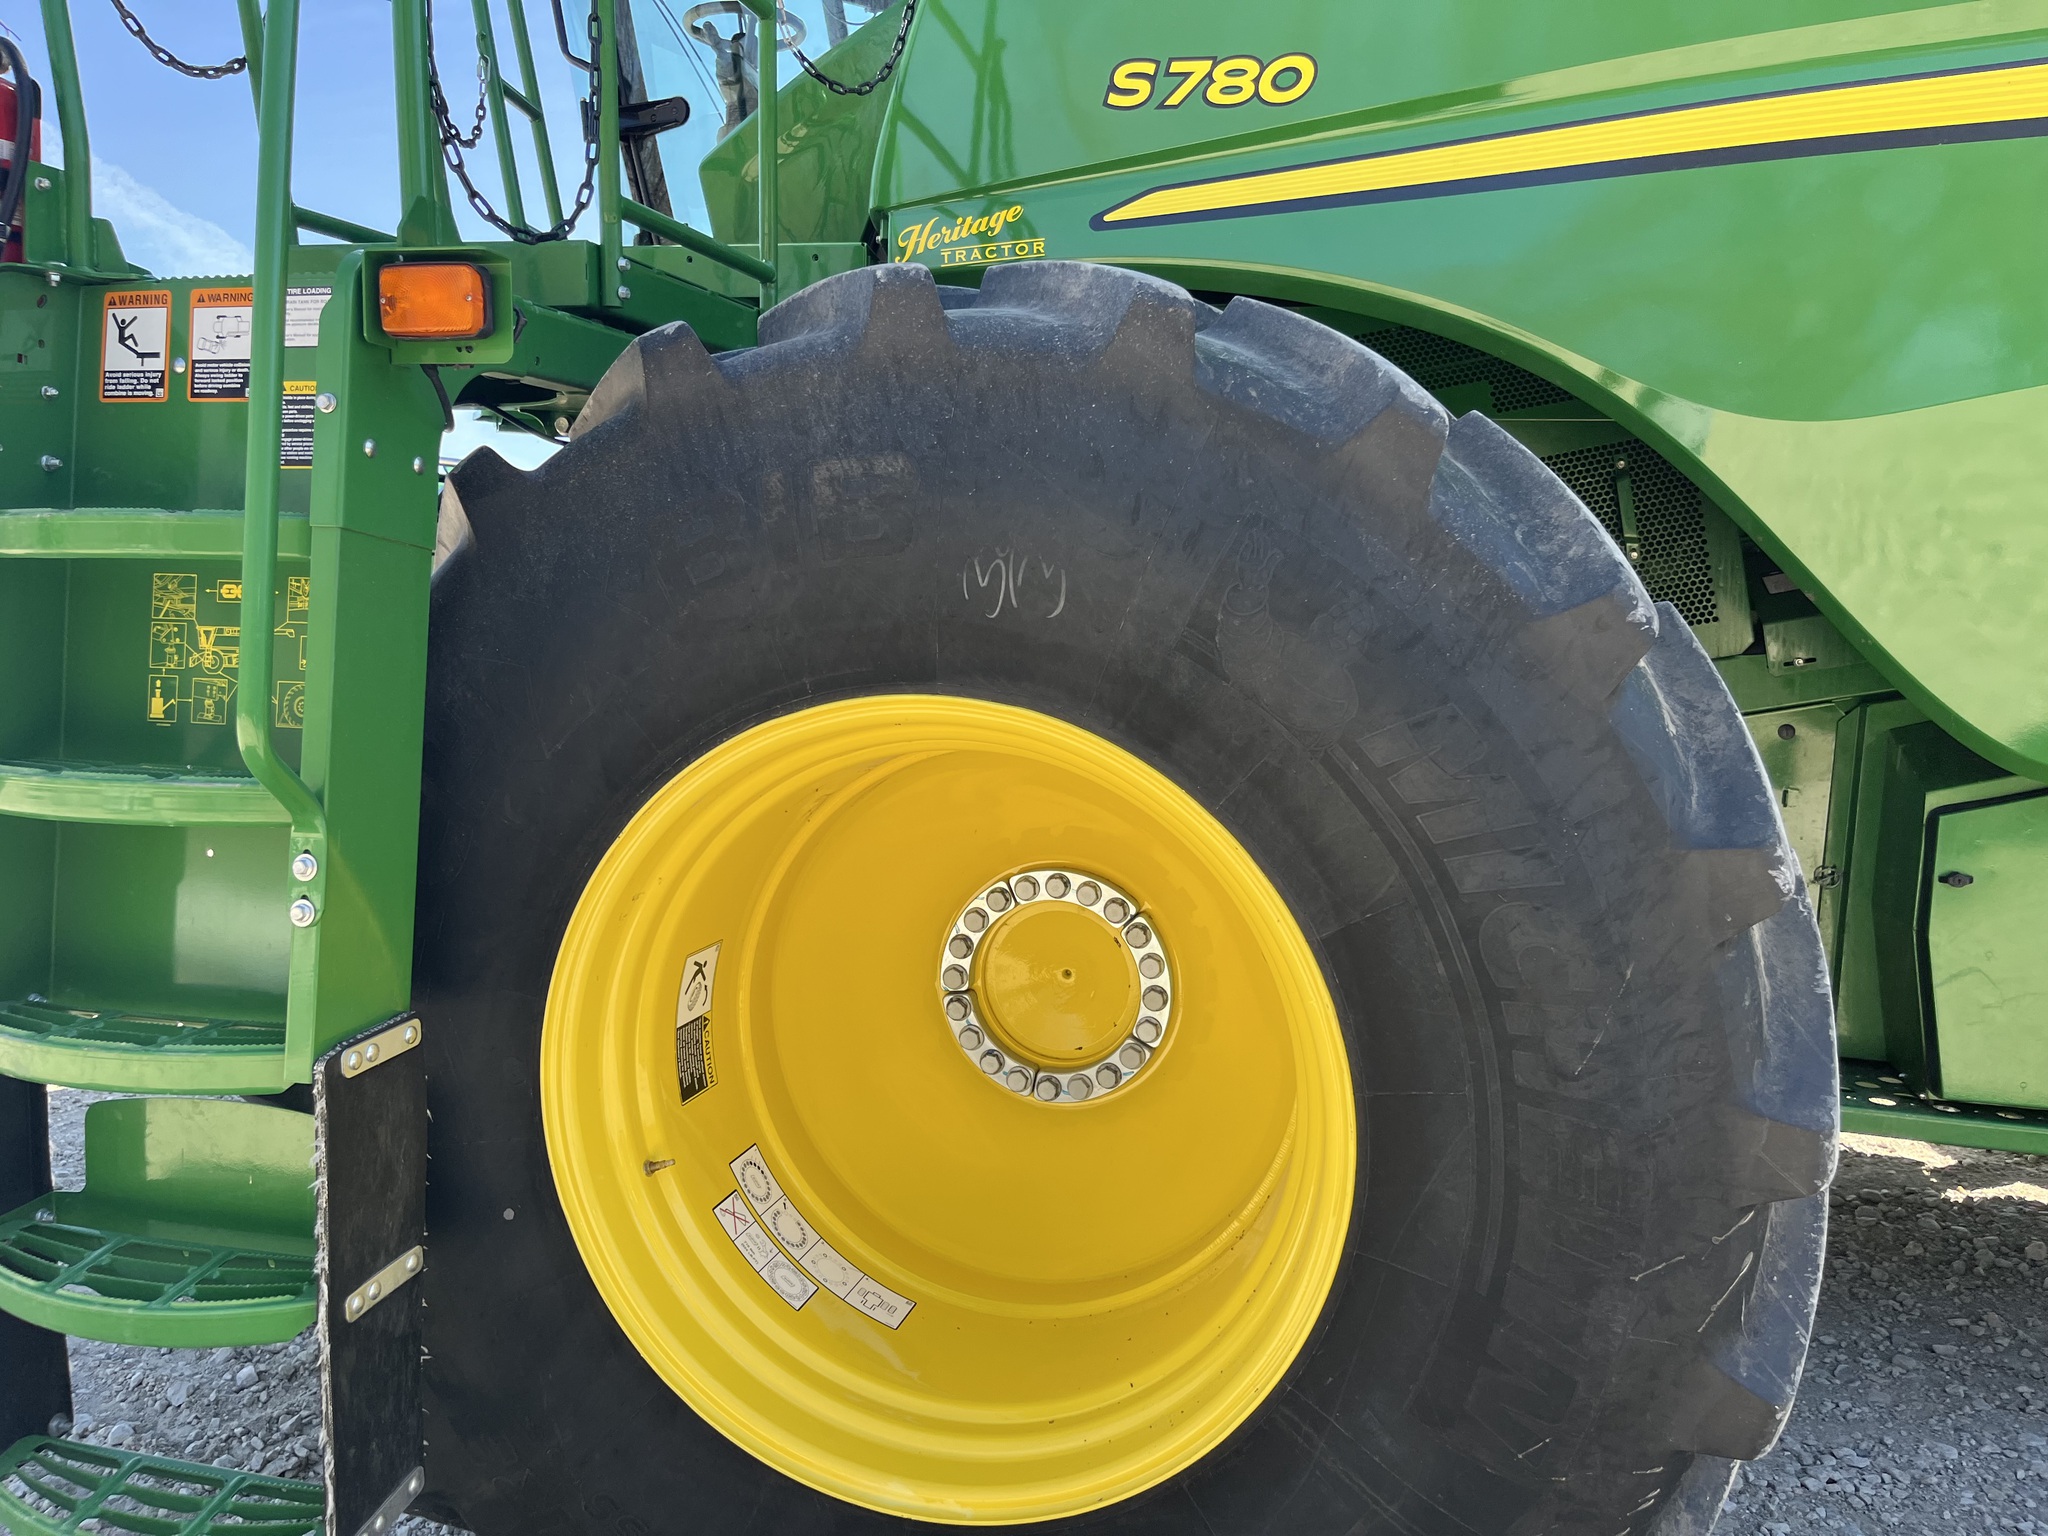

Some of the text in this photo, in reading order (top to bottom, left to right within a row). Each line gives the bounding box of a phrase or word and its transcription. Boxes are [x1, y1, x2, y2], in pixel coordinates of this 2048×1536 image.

[1103, 52, 1318, 111] S780
[895, 205, 1024, 264] Heritage
[941, 241, 1045, 264] TRACTOR
[118, 294, 168, 306] WARNING
[207, 293, 253, 303] WARNING
[145, 371, 163, 379] injury
[704, 1030, 715, 1084] CAUTION
